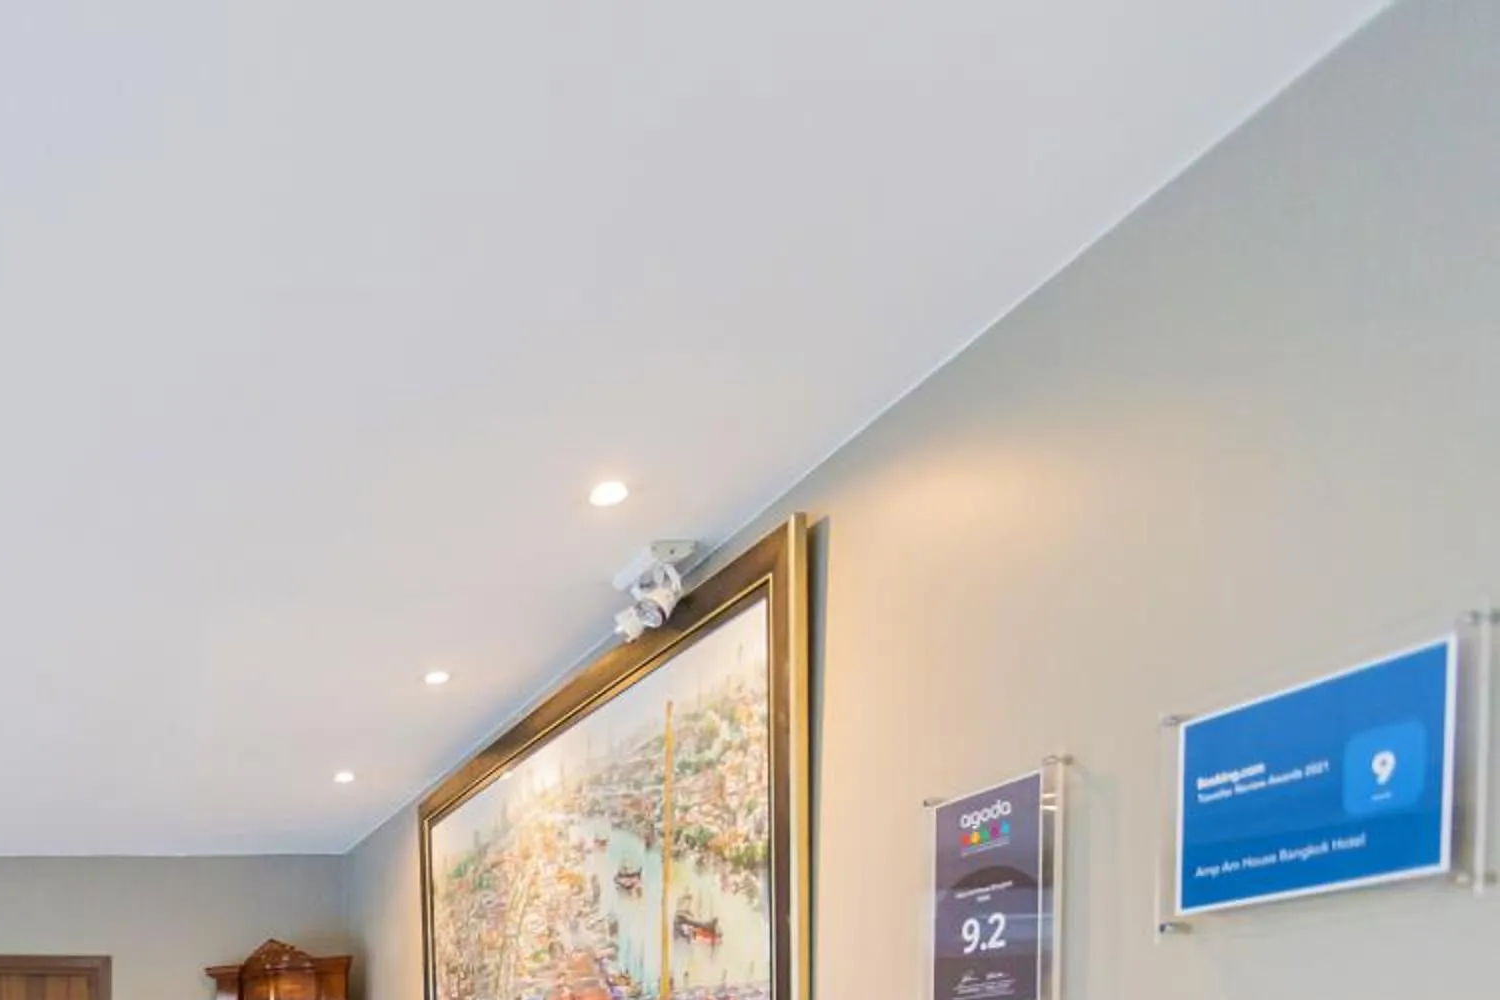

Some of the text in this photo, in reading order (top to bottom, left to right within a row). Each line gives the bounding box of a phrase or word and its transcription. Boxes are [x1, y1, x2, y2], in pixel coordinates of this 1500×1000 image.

[1371, 751, 1396, 786] 9
[960, 800, 1013, 829] agoda
[962, 911, 1007, 955] 9.2
